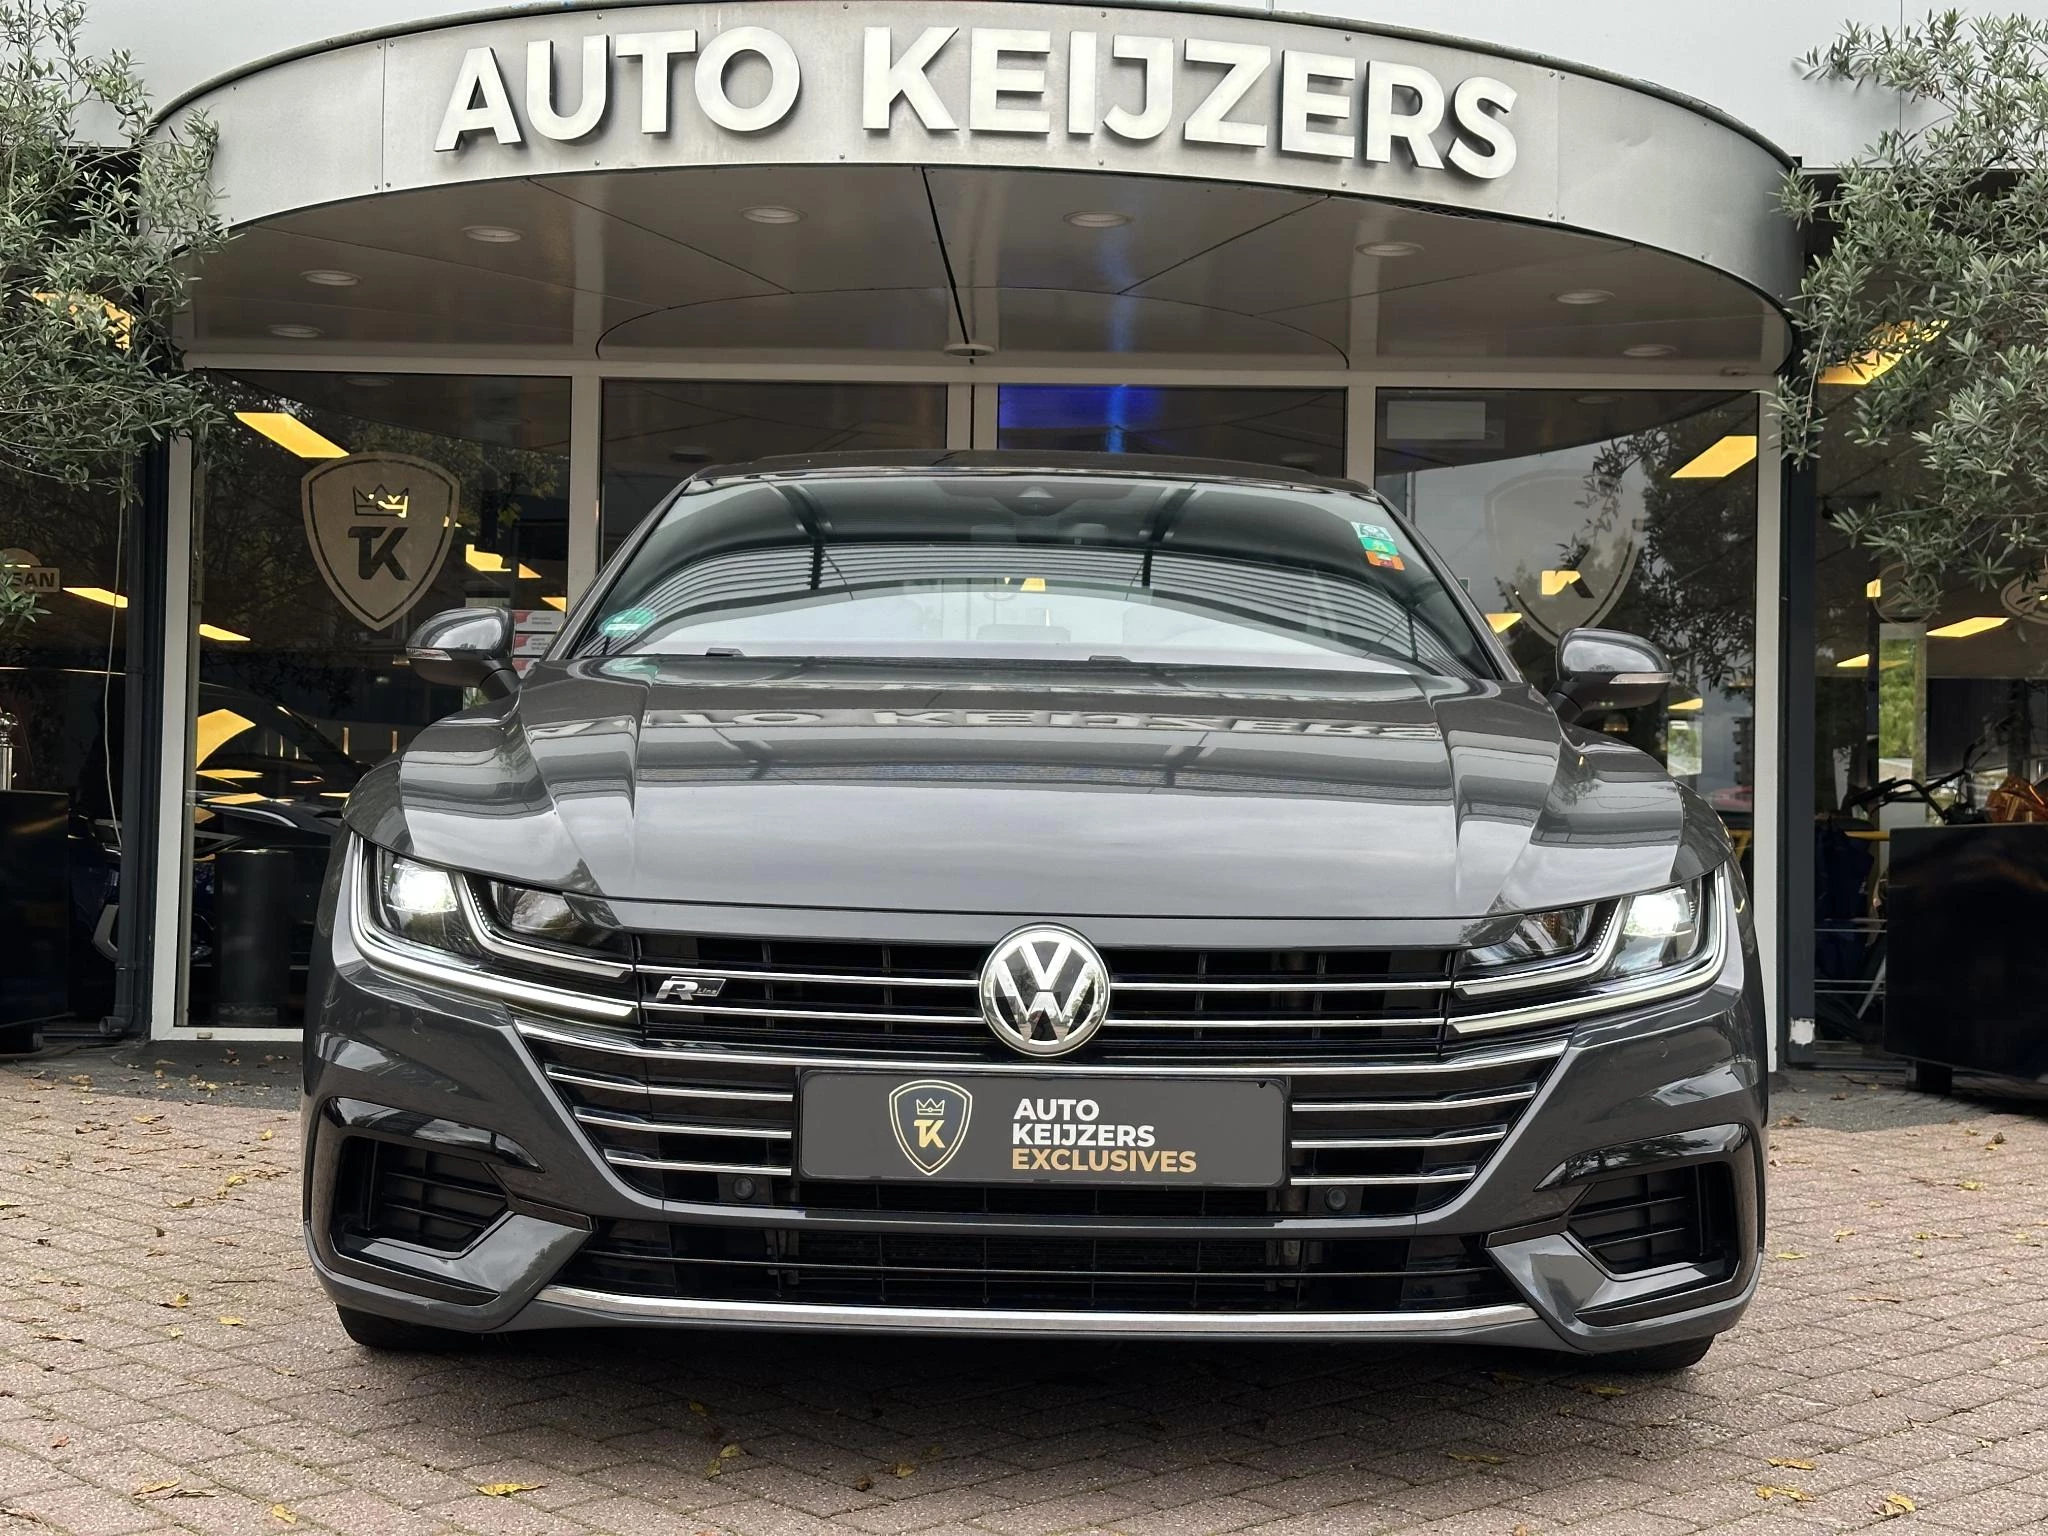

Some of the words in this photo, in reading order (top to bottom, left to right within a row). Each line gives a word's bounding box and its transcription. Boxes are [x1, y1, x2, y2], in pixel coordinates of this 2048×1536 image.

[434, 26, 802, 153] AUTO
[862, 26, 1518, 180] KEIJZERS
[348, 526, 411, 581] TK
[656, 980, 698, 1001] R
[1013, 1098, 1099, 1122] AUTO
[914, 1119, 946, 1149] TK
[1012, 1124, 1155, 1148] KEIJZERS
[1012, 1148, 1197, 1173] EXCLUSIVES
